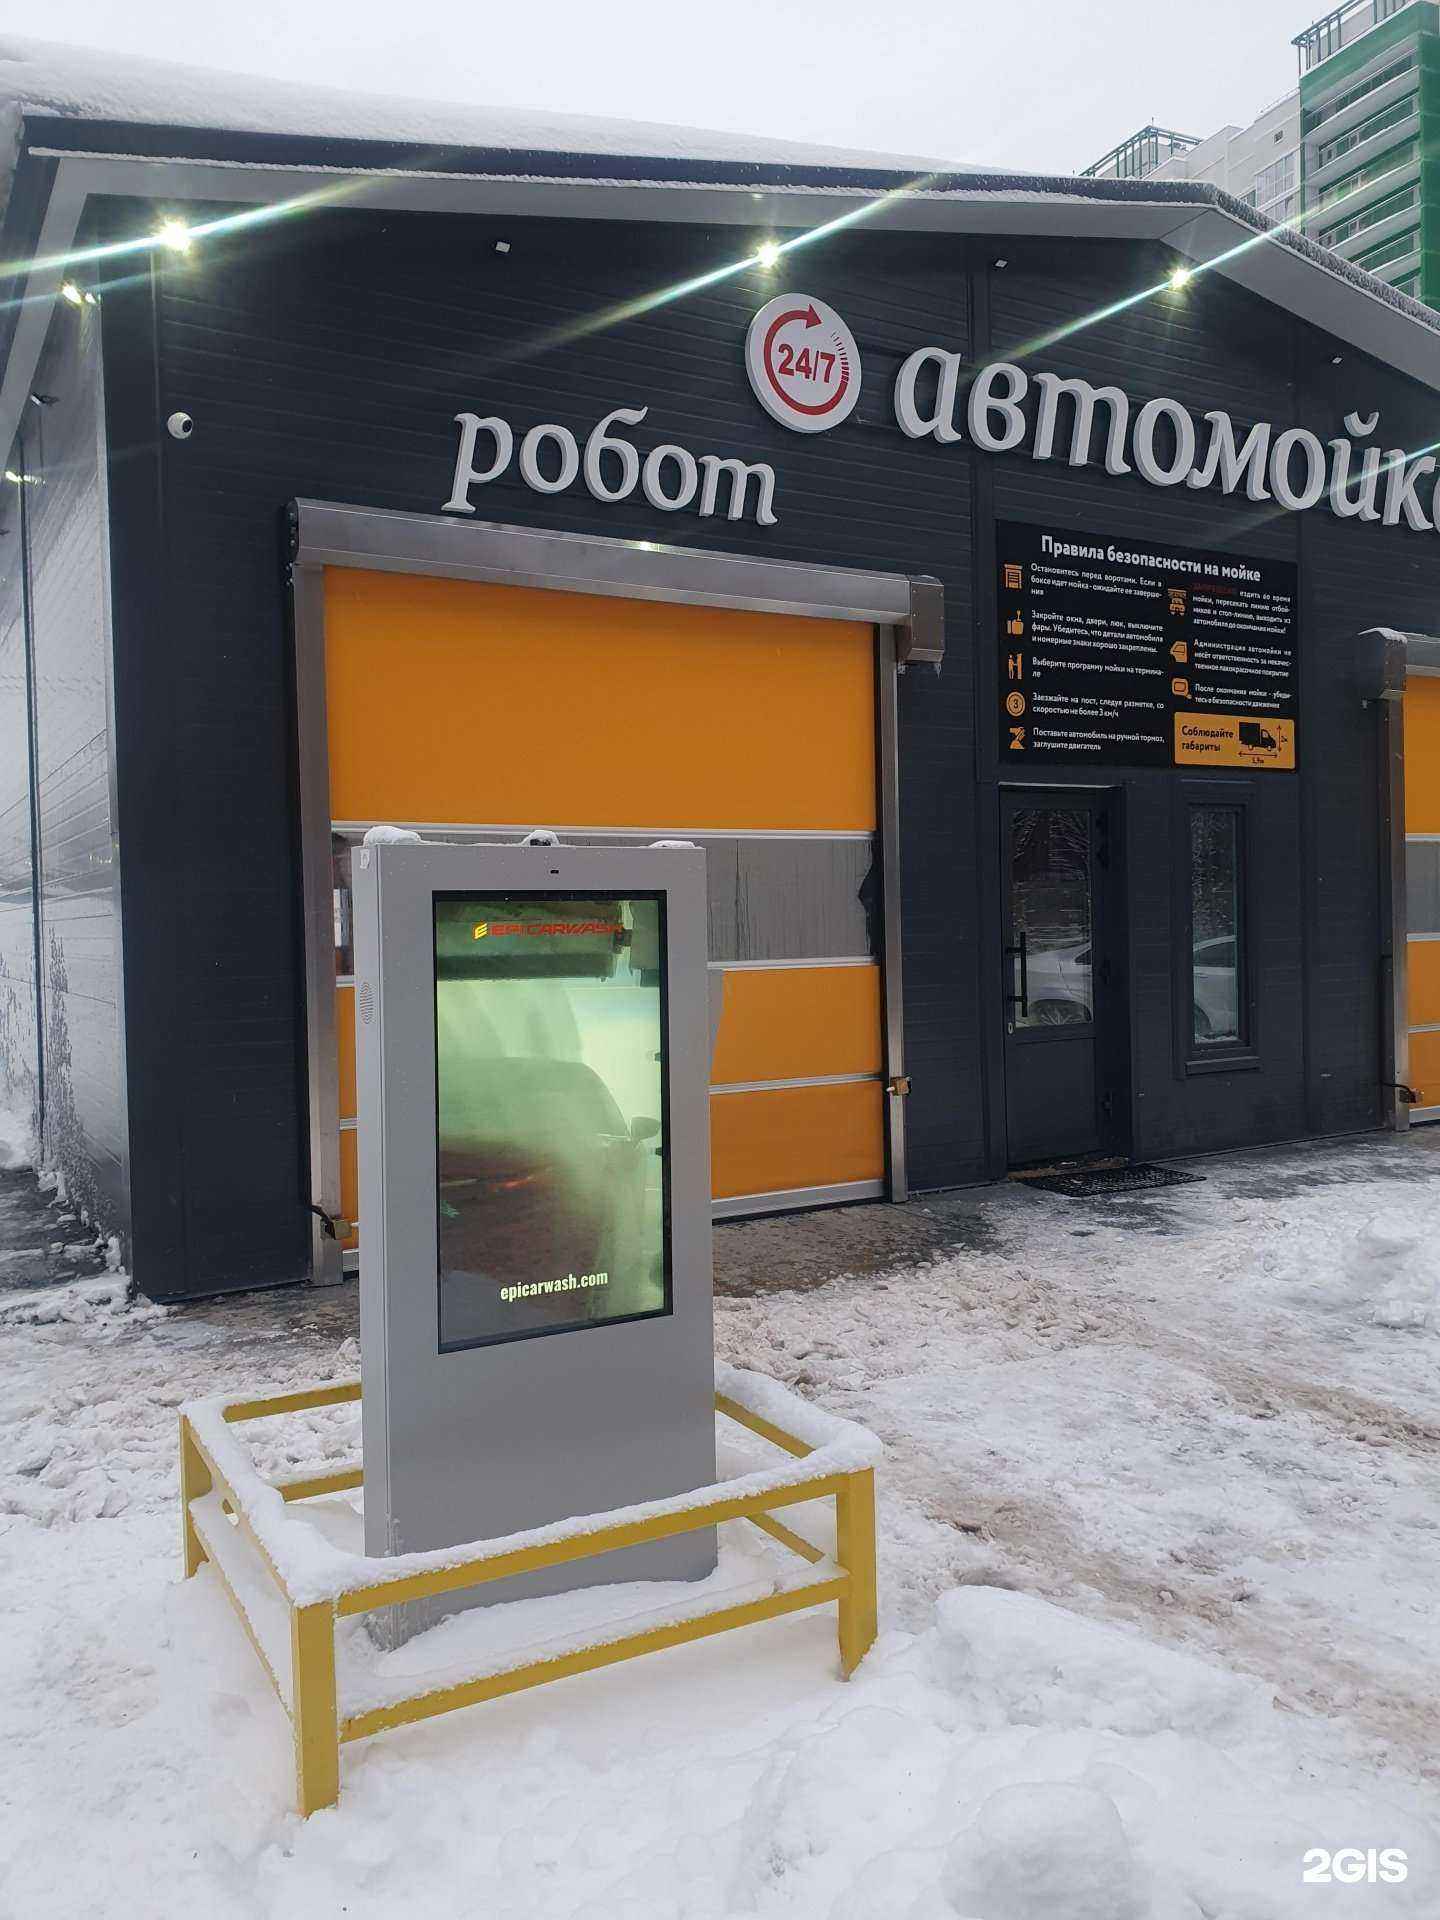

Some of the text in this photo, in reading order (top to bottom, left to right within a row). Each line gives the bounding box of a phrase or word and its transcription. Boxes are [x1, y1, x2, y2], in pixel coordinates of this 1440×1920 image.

[777, 343, 836, 384] 24/7
[893, 346, 1440, 536] автомойк
[441, 406, 779, 526] робот
[1041, 535, 1261, 581] Правила безопасности на мойке
[1031, 563, 1079, 577] Остановитесь
[1082, 571, 1102, 581] перед
[1140, 577, 1155, 587] Если
[1031, 574, 1051, 585] боксе
[1068, 580, 1089, 590] мойка
[1093, 583, 1124, 594] ожидайте
[1216, 599, 1249, 609] пересекать
[1032, 610, 1163, 632] Закройте окна, двери, люк, выключите
[1032, 622, 1052, 632] фары.
[1053, 624, 1090, 636] Убедитесь,
[1103, 630, 1125, 638] детали
[1038, 636, 1072, 647] номерные
[1093, 641, 1118, 650] хорошо
[1194, 639, 1246, 652] Администрация
[1248, 646, 1281, 656] автомойки
[1032, 657, 1067, 668] Выберите
[1068, 661, 1103, 672] программу
[1105, 664, 1126, 673] мойки
[1195, 683, 1214, 693] После
[1032, 692, 1068, 703] Заезжайте
[1081, 697, 1098, 706] пост,
[1100, 699, 1122, 708] следуя
[1124, 700, 1155, 709] разметке,
[1032, 706, 1070, 716] скоростью
[1070, 708, 1078, 716] не
[1079, 707, 1099, 717] более
[1104, 709, 1119, 718] км/ч
[1069, 730, 1108, 740] автомобиль
[1108, 732, 1116, 740] на
[1117, 731, 1140, 742] ручной
[1140, 735, 1165, 744] тормоз,
[1181, 725, 1234, 740] Соблюдайте
[1033, 740, 1102, 751] заглушите двигатель
[1181, 740, 1221, 753] габариты
[500, 1272, 608, 1302] epicarwash.com
